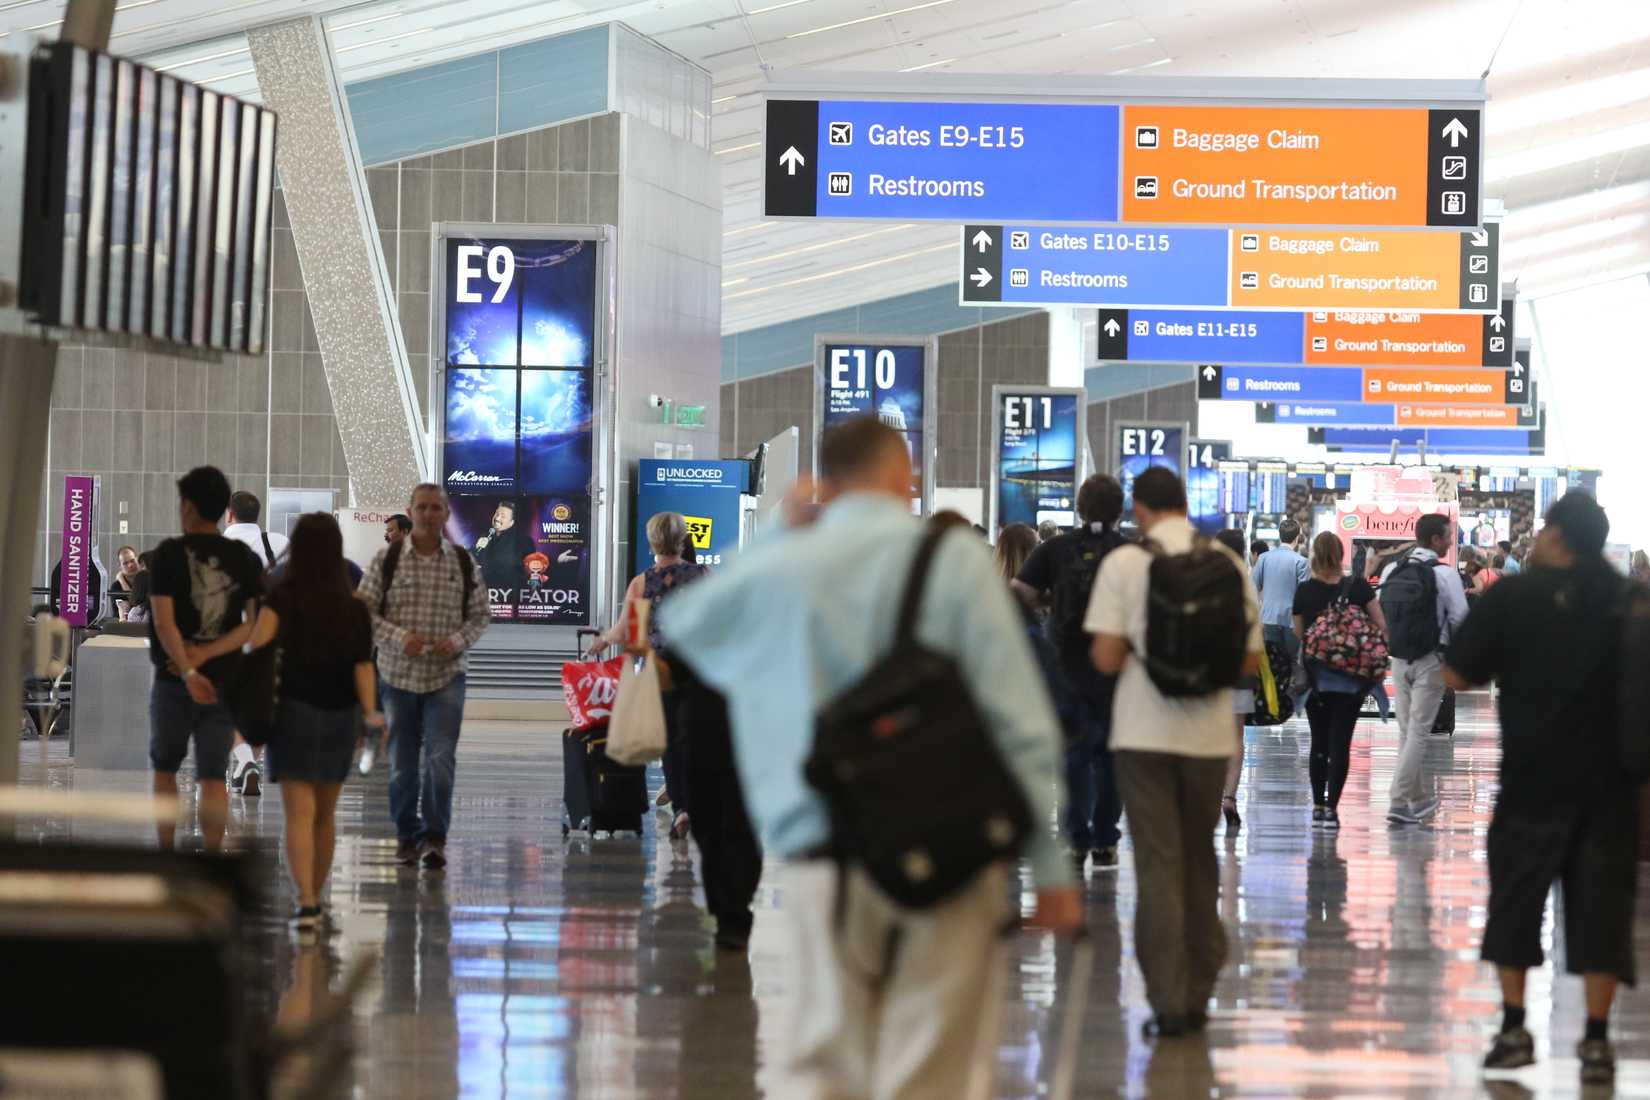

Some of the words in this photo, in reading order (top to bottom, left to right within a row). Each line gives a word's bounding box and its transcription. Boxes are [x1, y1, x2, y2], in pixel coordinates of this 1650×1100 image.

[869, 124, 931, 145] Gates
[941, 126, 1024, 147] E9-E15
[1174, 128, 1259, 151] Baggage
[1267, 130, 1319, 148] Claim
[870, 175, 984, 196] Restrooms
[1173, 179, 1245, 198] Ground
[1252, 180, 1396, 202] Transportation
[1041, 233, 1087, 249] Gates
[1094, 234, 1169, 250] E10-E15
[1270, 237, 1334, 254] Baggage
[1340, 237, 1379, 252] Claim
[457, 243, 515, 303] E9
[1041, 271, 1127, 287] Restrooms
[1269, 273, 1321, 289] Ground
[1326, 275, 1437, 292] Transportation
[1335, 313, 1385, 324] Baggage
[1389, 313, 1421, 323] Claim
[1156, 322, 1193, 336] Gates
[1198, 323, 1256, 336] E11-E15
[1335, 339, 1377, 351] Ground
[1382, 340, 1465, 353] Transportation
[831, 349, 896, 389] E10
[1246, 379, 1300, 391] Restrooms
[1387, 381, 1421, 393] Ground
[1424, 382, 1492, 393] Transportation
[1005, 397, 1052, 429] E11
[1123, 429, 1164, 455] E12
[1189, 445, 1212, 468] 14
[667, 468, 723, 478] UNLOCKED
[70, 489, 83, 532] HAND
[542, 522, 580, 533] WINNER!
[1362, 515, 1416, 534] benefi
[66, 536, 82, 613] SANITIZER
[519, 589, 580, 603] FATOR
